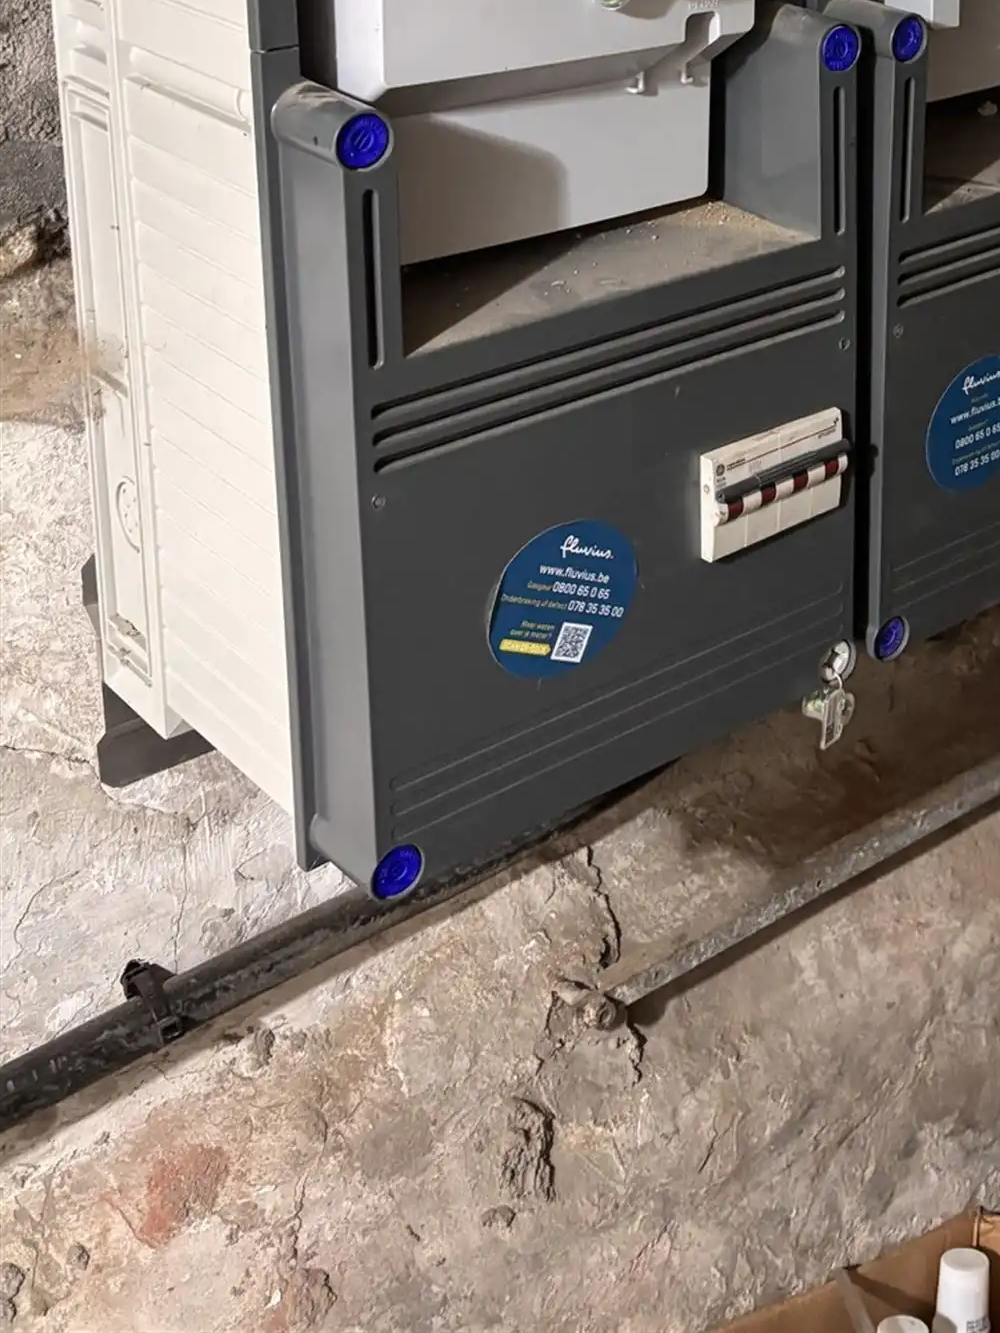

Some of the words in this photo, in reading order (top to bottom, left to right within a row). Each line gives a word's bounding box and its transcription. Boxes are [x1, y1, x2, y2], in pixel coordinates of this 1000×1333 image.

[539, 564, 610, 584] www.fluvius.be
[552, 581, 576, 595] 0800
[577, 584, 589, 597] 65
[590, 586, 597, 598] 0
[598, 588, 611, 600] 65
[567, 599, 586, 613] 078
[586, 603, 598, 615] 35
[598, 605, 611, 616] 35
[611, 606, 625, 618] 00
